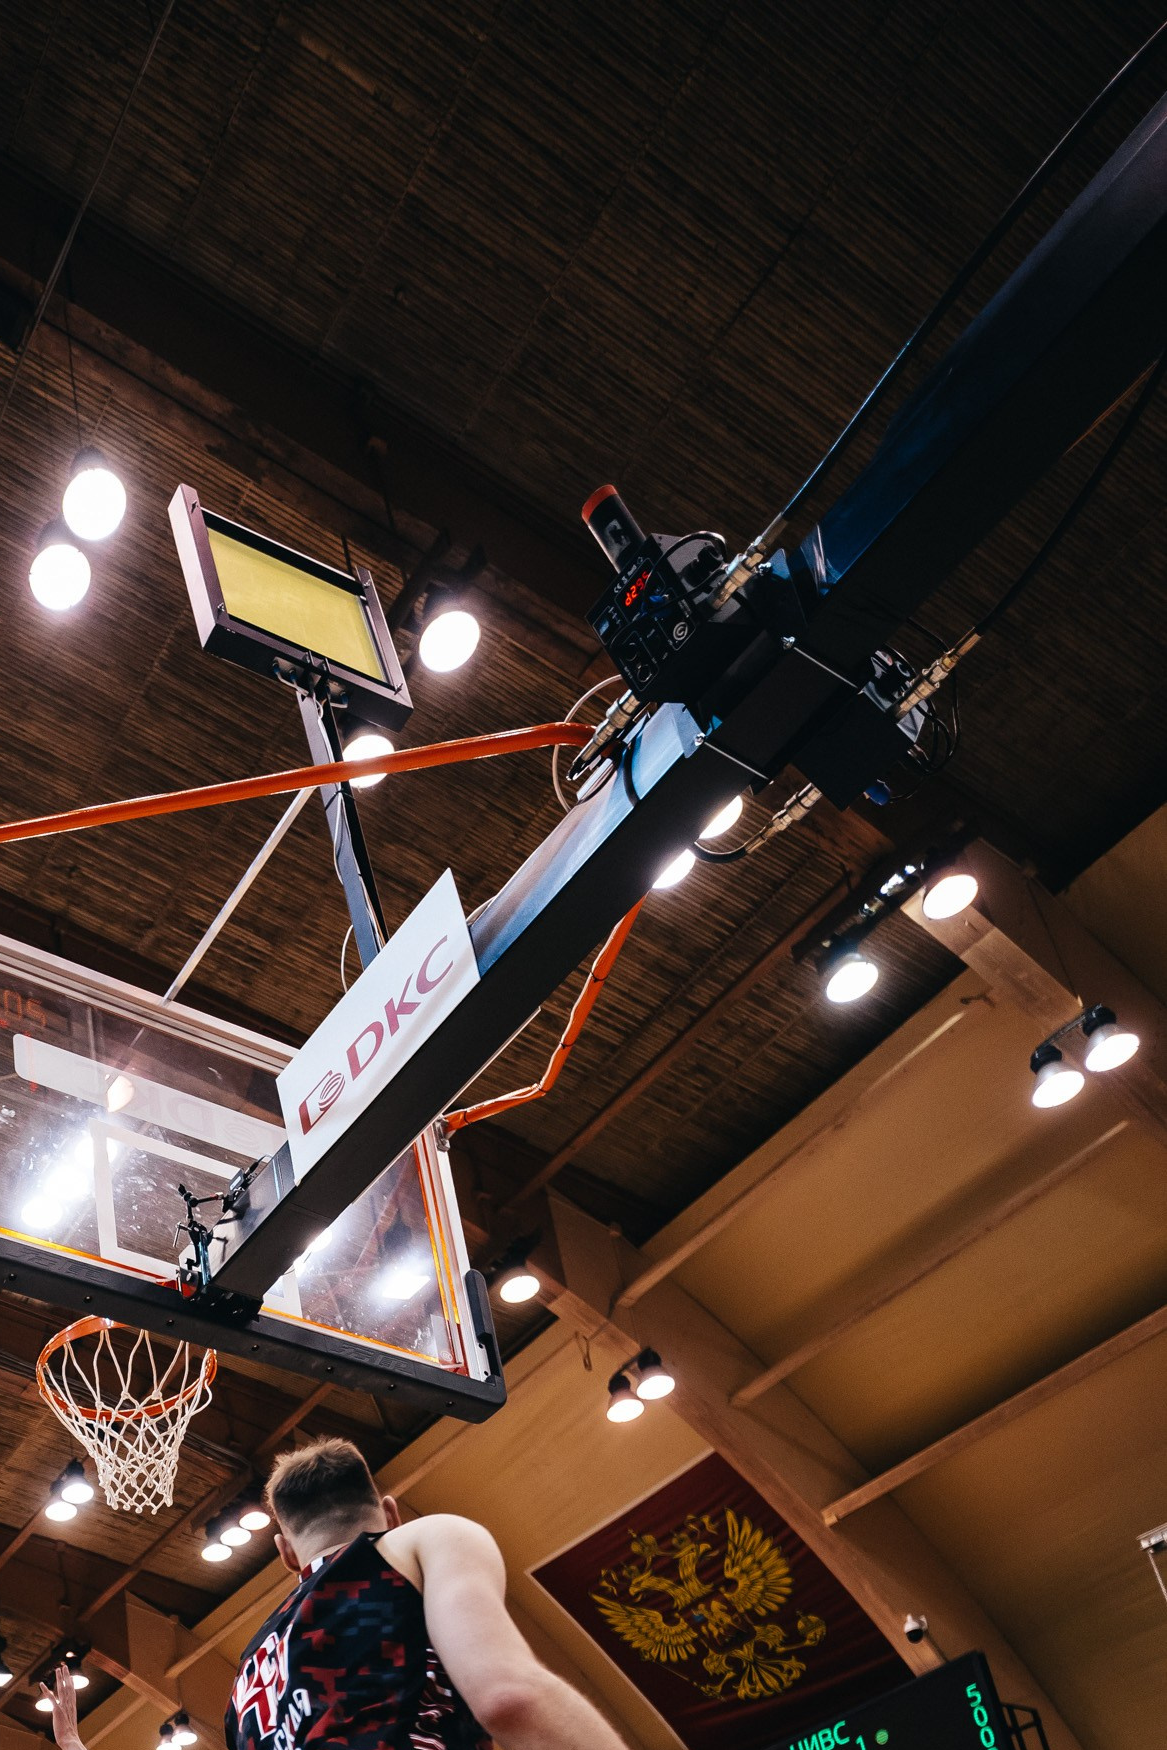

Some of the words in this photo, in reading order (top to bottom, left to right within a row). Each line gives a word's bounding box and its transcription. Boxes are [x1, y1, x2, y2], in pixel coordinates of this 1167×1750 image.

[346, 935, 454, 1081] DKC
[965, 1683, 983, 1708] 5
[973, 1705, 989, 1728] 0
[979, 1725, 996, 1749] 0
